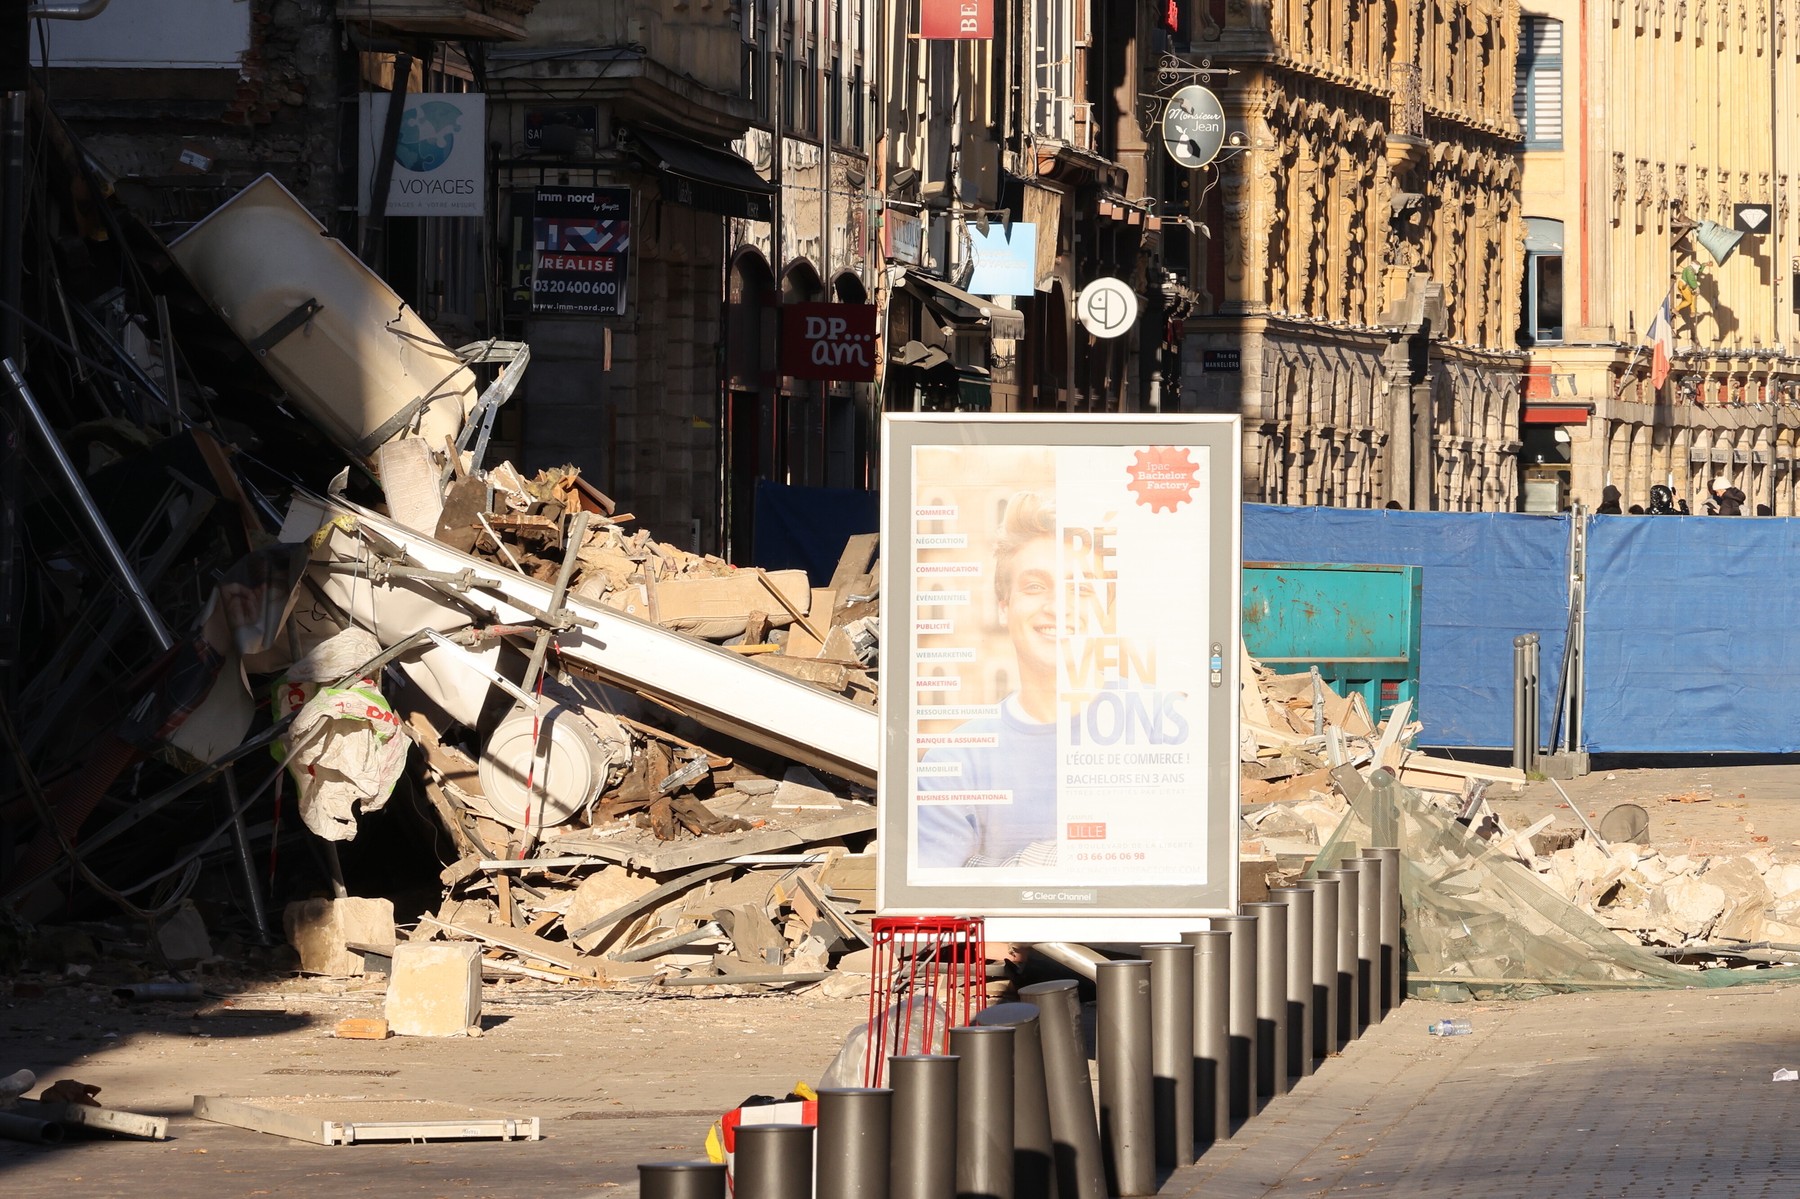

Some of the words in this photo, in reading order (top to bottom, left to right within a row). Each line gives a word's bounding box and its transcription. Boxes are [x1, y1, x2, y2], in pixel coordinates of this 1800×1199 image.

[1168, 108, 1221, 121] Monsieur
[1192, 120, 1219, 132] Jean
[399, 179, 475, 195] VOYAGES
[537, 191, 562, 202] imm
[567, 192, 595, 203] nord
[544, 256, 613, 272] RÉALISÉ
[532, 302, 615, 312] www.imm-nord.pro
[811, 340, 869, 367] am
[1145, 461, 1170, 472] Ipac
[1138, 471, 1187, 480] Bachelor
[1146, 480, 1189, 491] Factory
[915, 537, 964, 545] NÉGOCIATION
[1063, 511, 1118, 580] RÉ
[915, 593, 967, 602] ÉVÉNEMENTIEL
[1065, 582, 1116, 635] IN
[915, 621, 951, 630] PUBLICITÉ
[916, 651, 973, 659] WEBMARKETING
[1060, 637, 1157, 690] VEN
[916, 708, 960, 716] RESSOURCES
[1061, 691, 1189, 746] TONS
[916, 737, 946, 745] BANQUE
[954, 736, 996, 744] ASSURANCE
[1066, 751, 1104, 766] L'ÉCOLE
[1107, 754, 1121, 766] DE
[1123, 752, 1184, 765] COMMERCE
[1066, 774, 1132, 785] BACHELORS
[1135, 774, 1149, 783] EN
[1152, 773, 1159, 783] 3
[1161, 773, 1185, 783] ANS
[1069, 825, 1104, 838] LILLE
[1091, 852, 1103, 860] 66
[1105, 852, 1117, 860] 06
[1119, 852, 1132, 860] 06
[1134, 852, 1145, 860] 98
[1034, 891, 1056, 900] Clear
[1057, 891, 1091, 901] Channel
